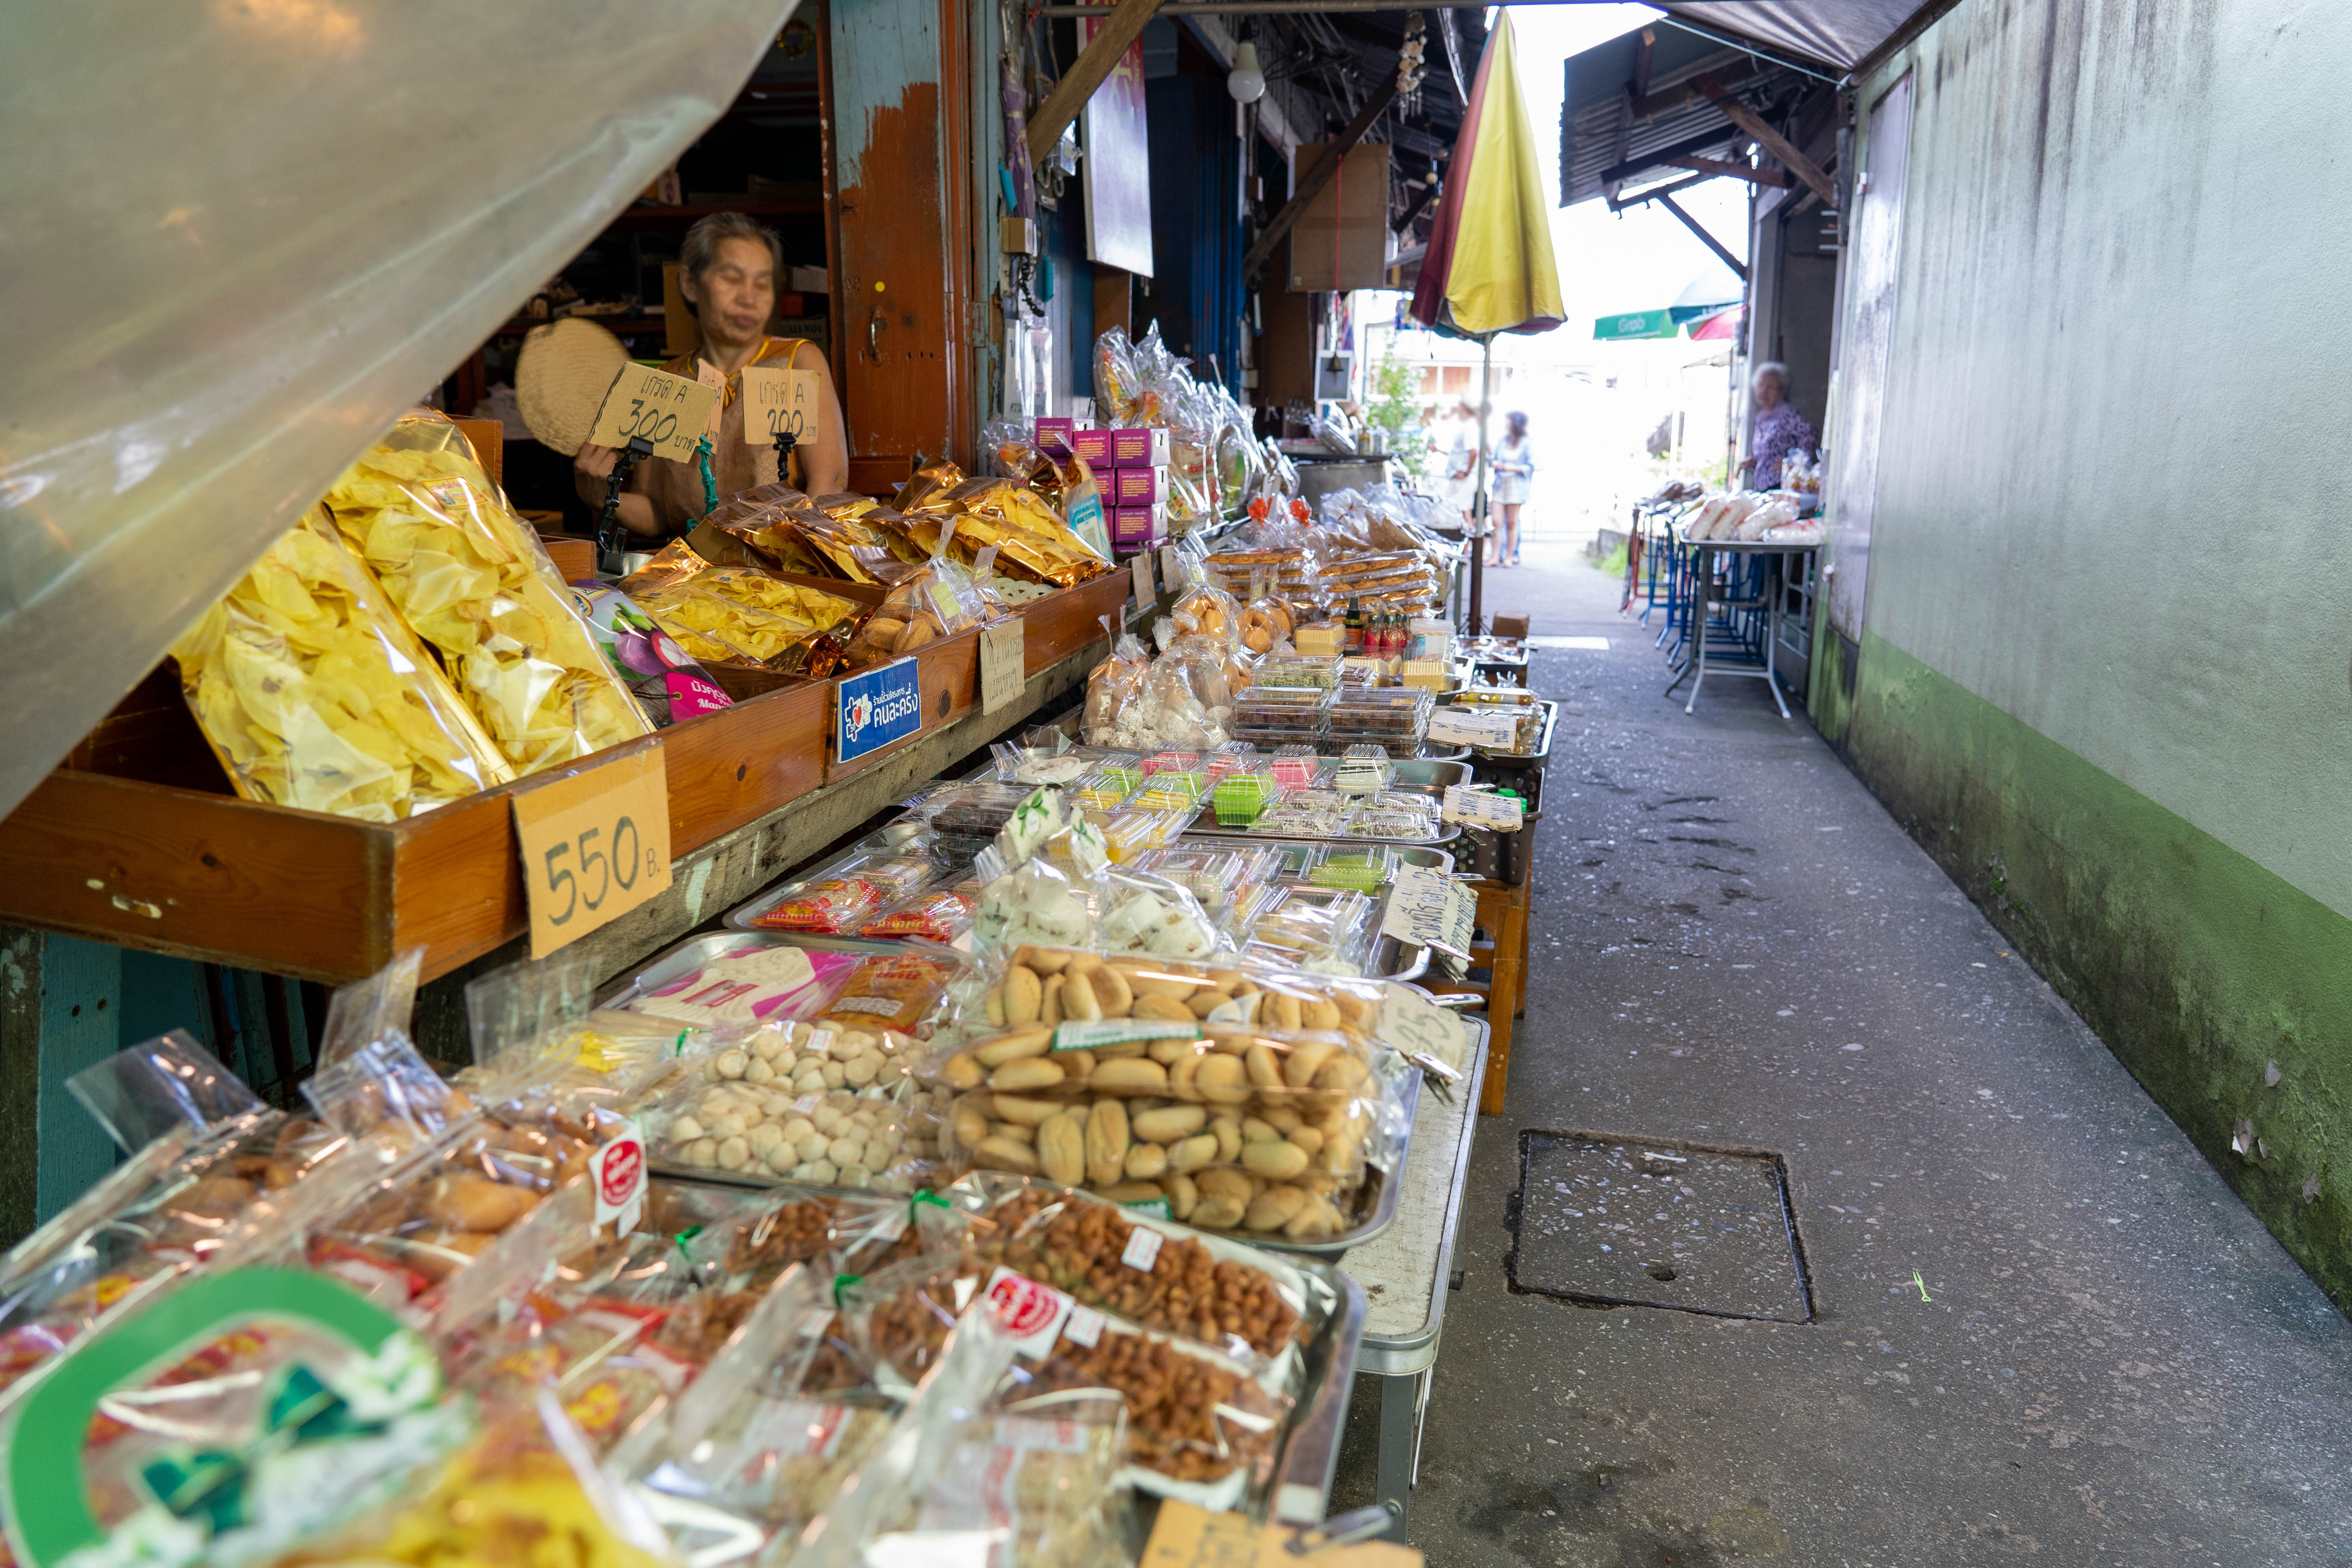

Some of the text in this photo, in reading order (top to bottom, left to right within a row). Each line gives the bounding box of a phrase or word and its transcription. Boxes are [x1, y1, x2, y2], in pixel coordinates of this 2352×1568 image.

[1617, 315, 1645, 332] Grab
[640, 375, 688, 403] เกรด A
[715, 386, 722, 406] A
[760, 382, 804, 405] เกรด A
[619, 399, 677, 443] 300
[674, 435, 696, 452] บาท
[767, 409, 803, 439] 200
[697, 698, 724, 710] Man
[873, 688, 905, 706] ร้านนี้ร่วมโครงการ
[874, 682, 918, 728] คนละครึ่ง
[850, 723, 856, 732] 50
[545, 816, 660, 926] 550 B.
[1395, 1007, 1451, 1058] 25
